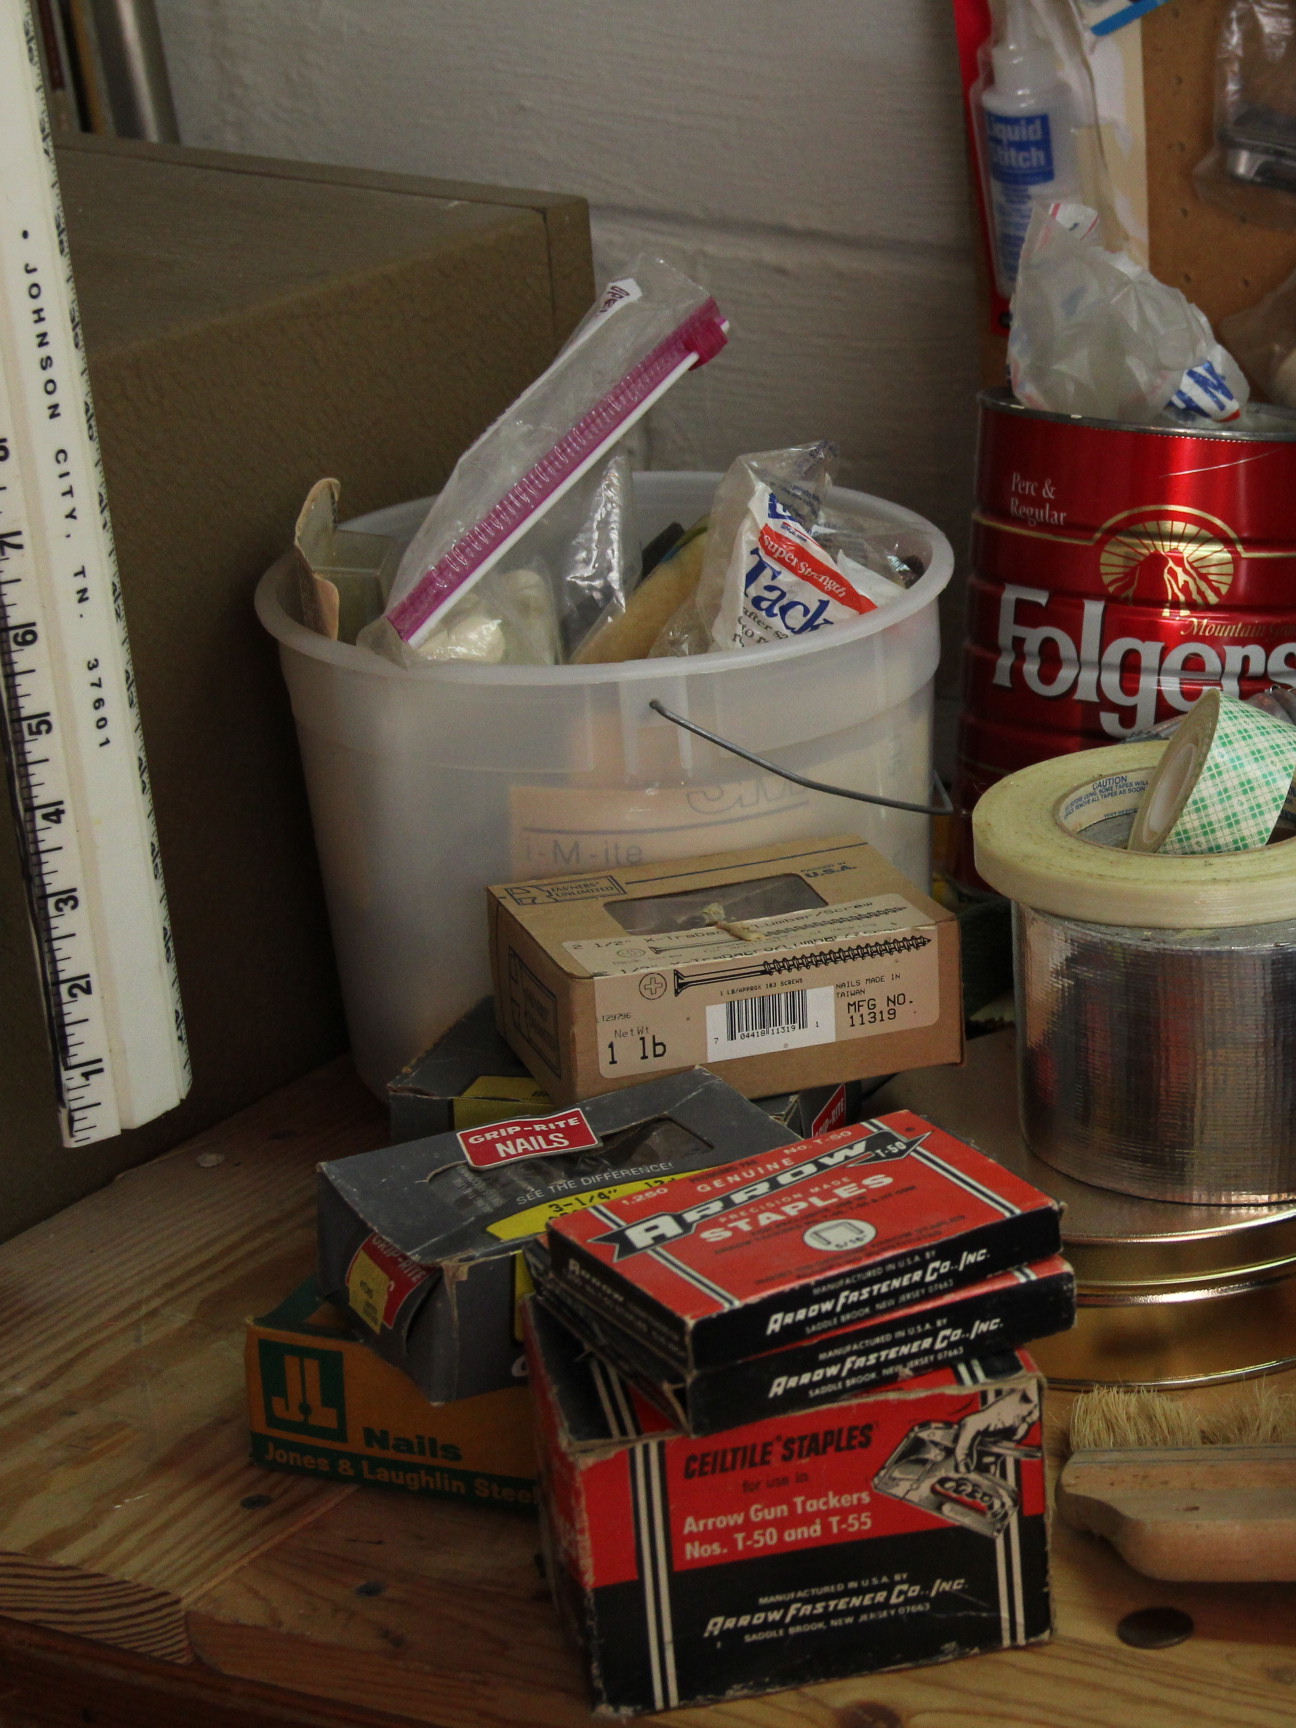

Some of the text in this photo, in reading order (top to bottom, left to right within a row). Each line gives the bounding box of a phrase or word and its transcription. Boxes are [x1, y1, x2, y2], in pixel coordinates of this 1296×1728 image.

[1011, 472, 1056, 500] Perc &
[24, 262, 61, 420] JOHNSON
[86, 657, 111, 749] 37601
[1009, 498, 1067, 527] Regular
[763, 534, 799, 567] Super
[1180, 616, 1265, 638] Mountain
[27, 718, 53, 736] 5
[1092, 775, 1127, 790] CAUTION
[41, 808, 66, 825] 4
[54, 894, 79, 912] 3
[67, 979, 93, 999] 2
[835, 979, 862, 990] NAILS
[865, 976, 886, 985] MADE
[835, 988, 866, 998] TAIWAN
[847, 993, 914, 1014] MFG NO.
[849, 1008, 897, 1027] 11319
[740, 1029, 766, 1040] 04418
[770, 1024, 796, 1035] 11319
[608, 1034, 667, 1065] 1 lb
[81, 1067, 105, 1082] 1
[468, 1117, 580, 1144] GRIP-RITE
[813, 1130, 852, 1146] T-50
[495, 1132, 570, 1158] NAILS
[875, 1141, 907, 1158] T-50
[516, 1190, 544, 1205] SEE
[548, 1179, 578, 1194] THE
[580, 1161, 674, 1188] DIFFERENCE!
[696, 1158, 796, 1193] GENUINE
[699, 1173, 895, 1243] STAPLES
[719, 1176, 852, 1224] PRECISION MADE
[812, 1266, 884, 1295] MANUFACTURED
[886, 1261, 897, 1272] IN
[804, 1317, 839, 1334] SADDLE
[875, 1299, 897, 1311] NEW
[898, 1287, 927, 1305] JERSEY
[817, 1334, 892, 1361] MANUFACTURED
[894, 1328, 906, 1340] IN
[936, 1317, 948, 1328] BY
[807, 1380, 843, 1398] SADDLE
[362, 1426, 463, 1462] Nails
[781, 1423, 873, 1464] STAPLES
[264, 1441, 467, 1494] Jones & Laughlin
[742, 1470, 808, 1494] for use in
[682, 1489, 872, 1536] Arrow Gun Tackers
[684, 1512, 873, 1561] Nos. T-50 and T-55
[758, 1572, 908, 1606] MANUFACTURED IN BY
[743, 1602, 931, 1643] SADDLE NEW JERSEY 07663
